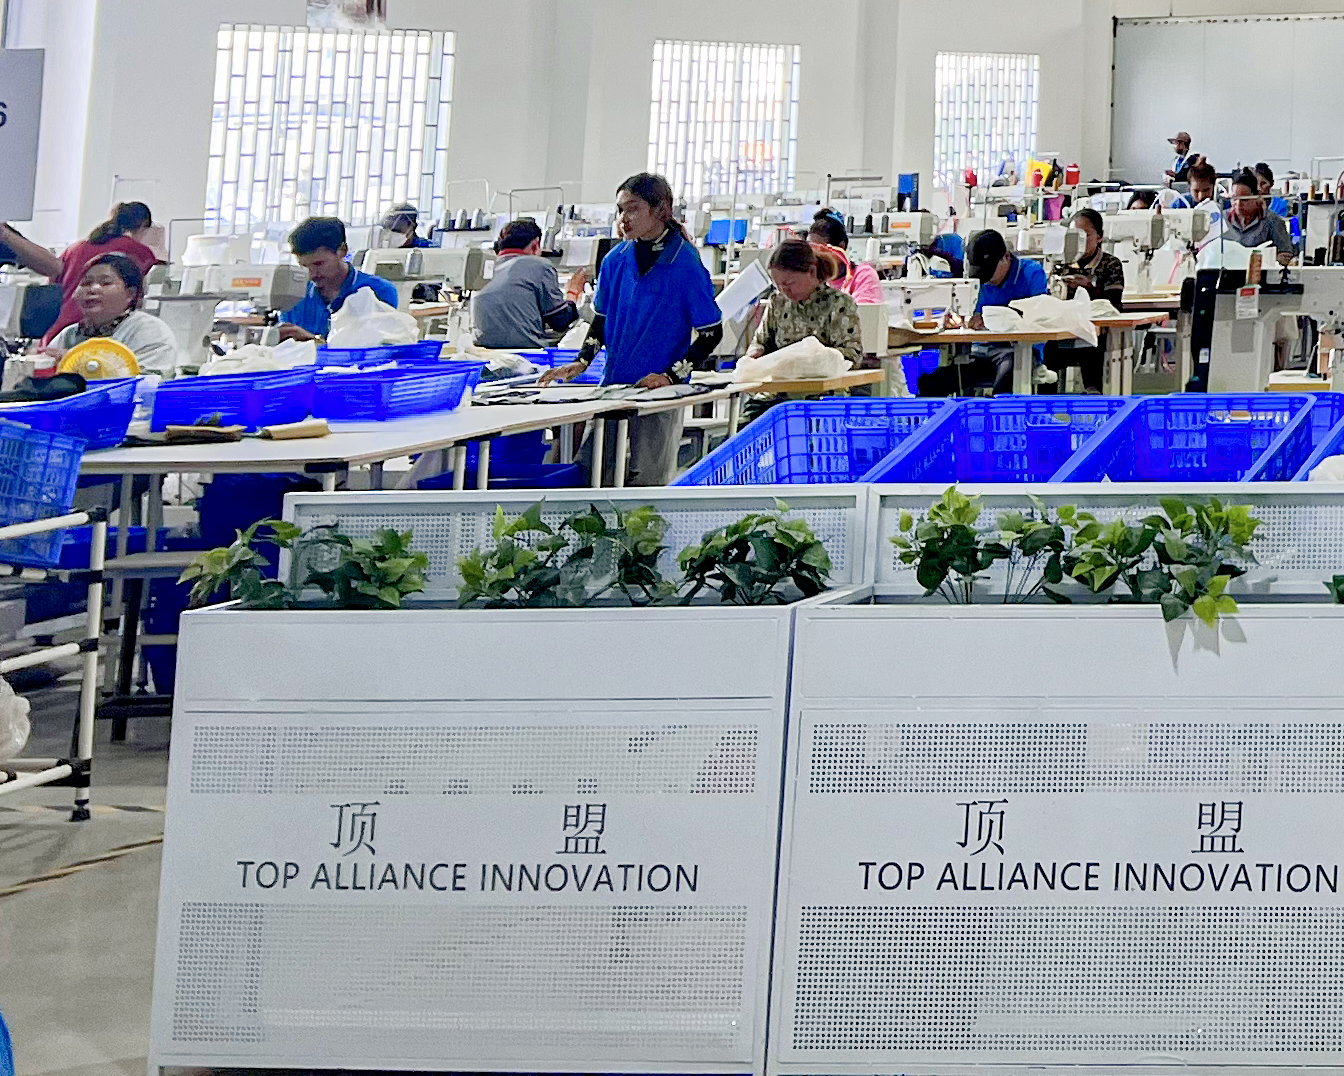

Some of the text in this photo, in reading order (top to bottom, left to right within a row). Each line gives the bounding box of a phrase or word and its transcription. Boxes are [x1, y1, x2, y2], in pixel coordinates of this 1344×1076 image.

[329, 801, 608, 857] 顶 盟
[955, 797, 1245, 857] 顶 盟
[236, 860, 699, 893] TOP ALLIANCE INNOVATION
[858, 861, 1339, 894] TOP ALLIANCE INNOVATION
